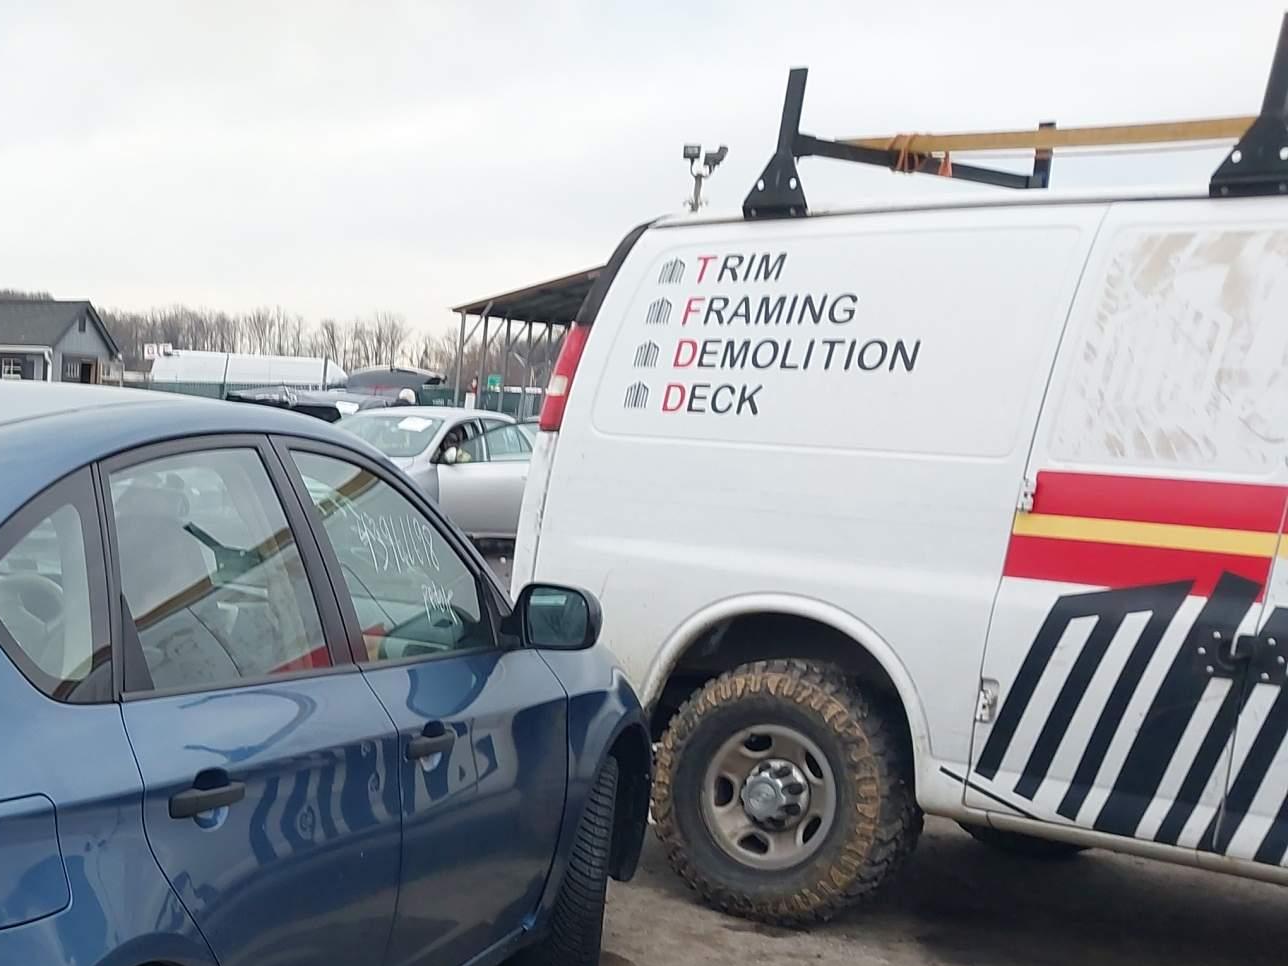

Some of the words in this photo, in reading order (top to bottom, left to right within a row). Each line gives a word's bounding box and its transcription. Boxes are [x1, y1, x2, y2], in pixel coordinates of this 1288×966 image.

[696, 252, 788, 284] TRIM
[681, 293, 858, 326] FRAMING
[673, 338, 921, 373] DEMOLITION
[661, 383, 763, 416] DECK
